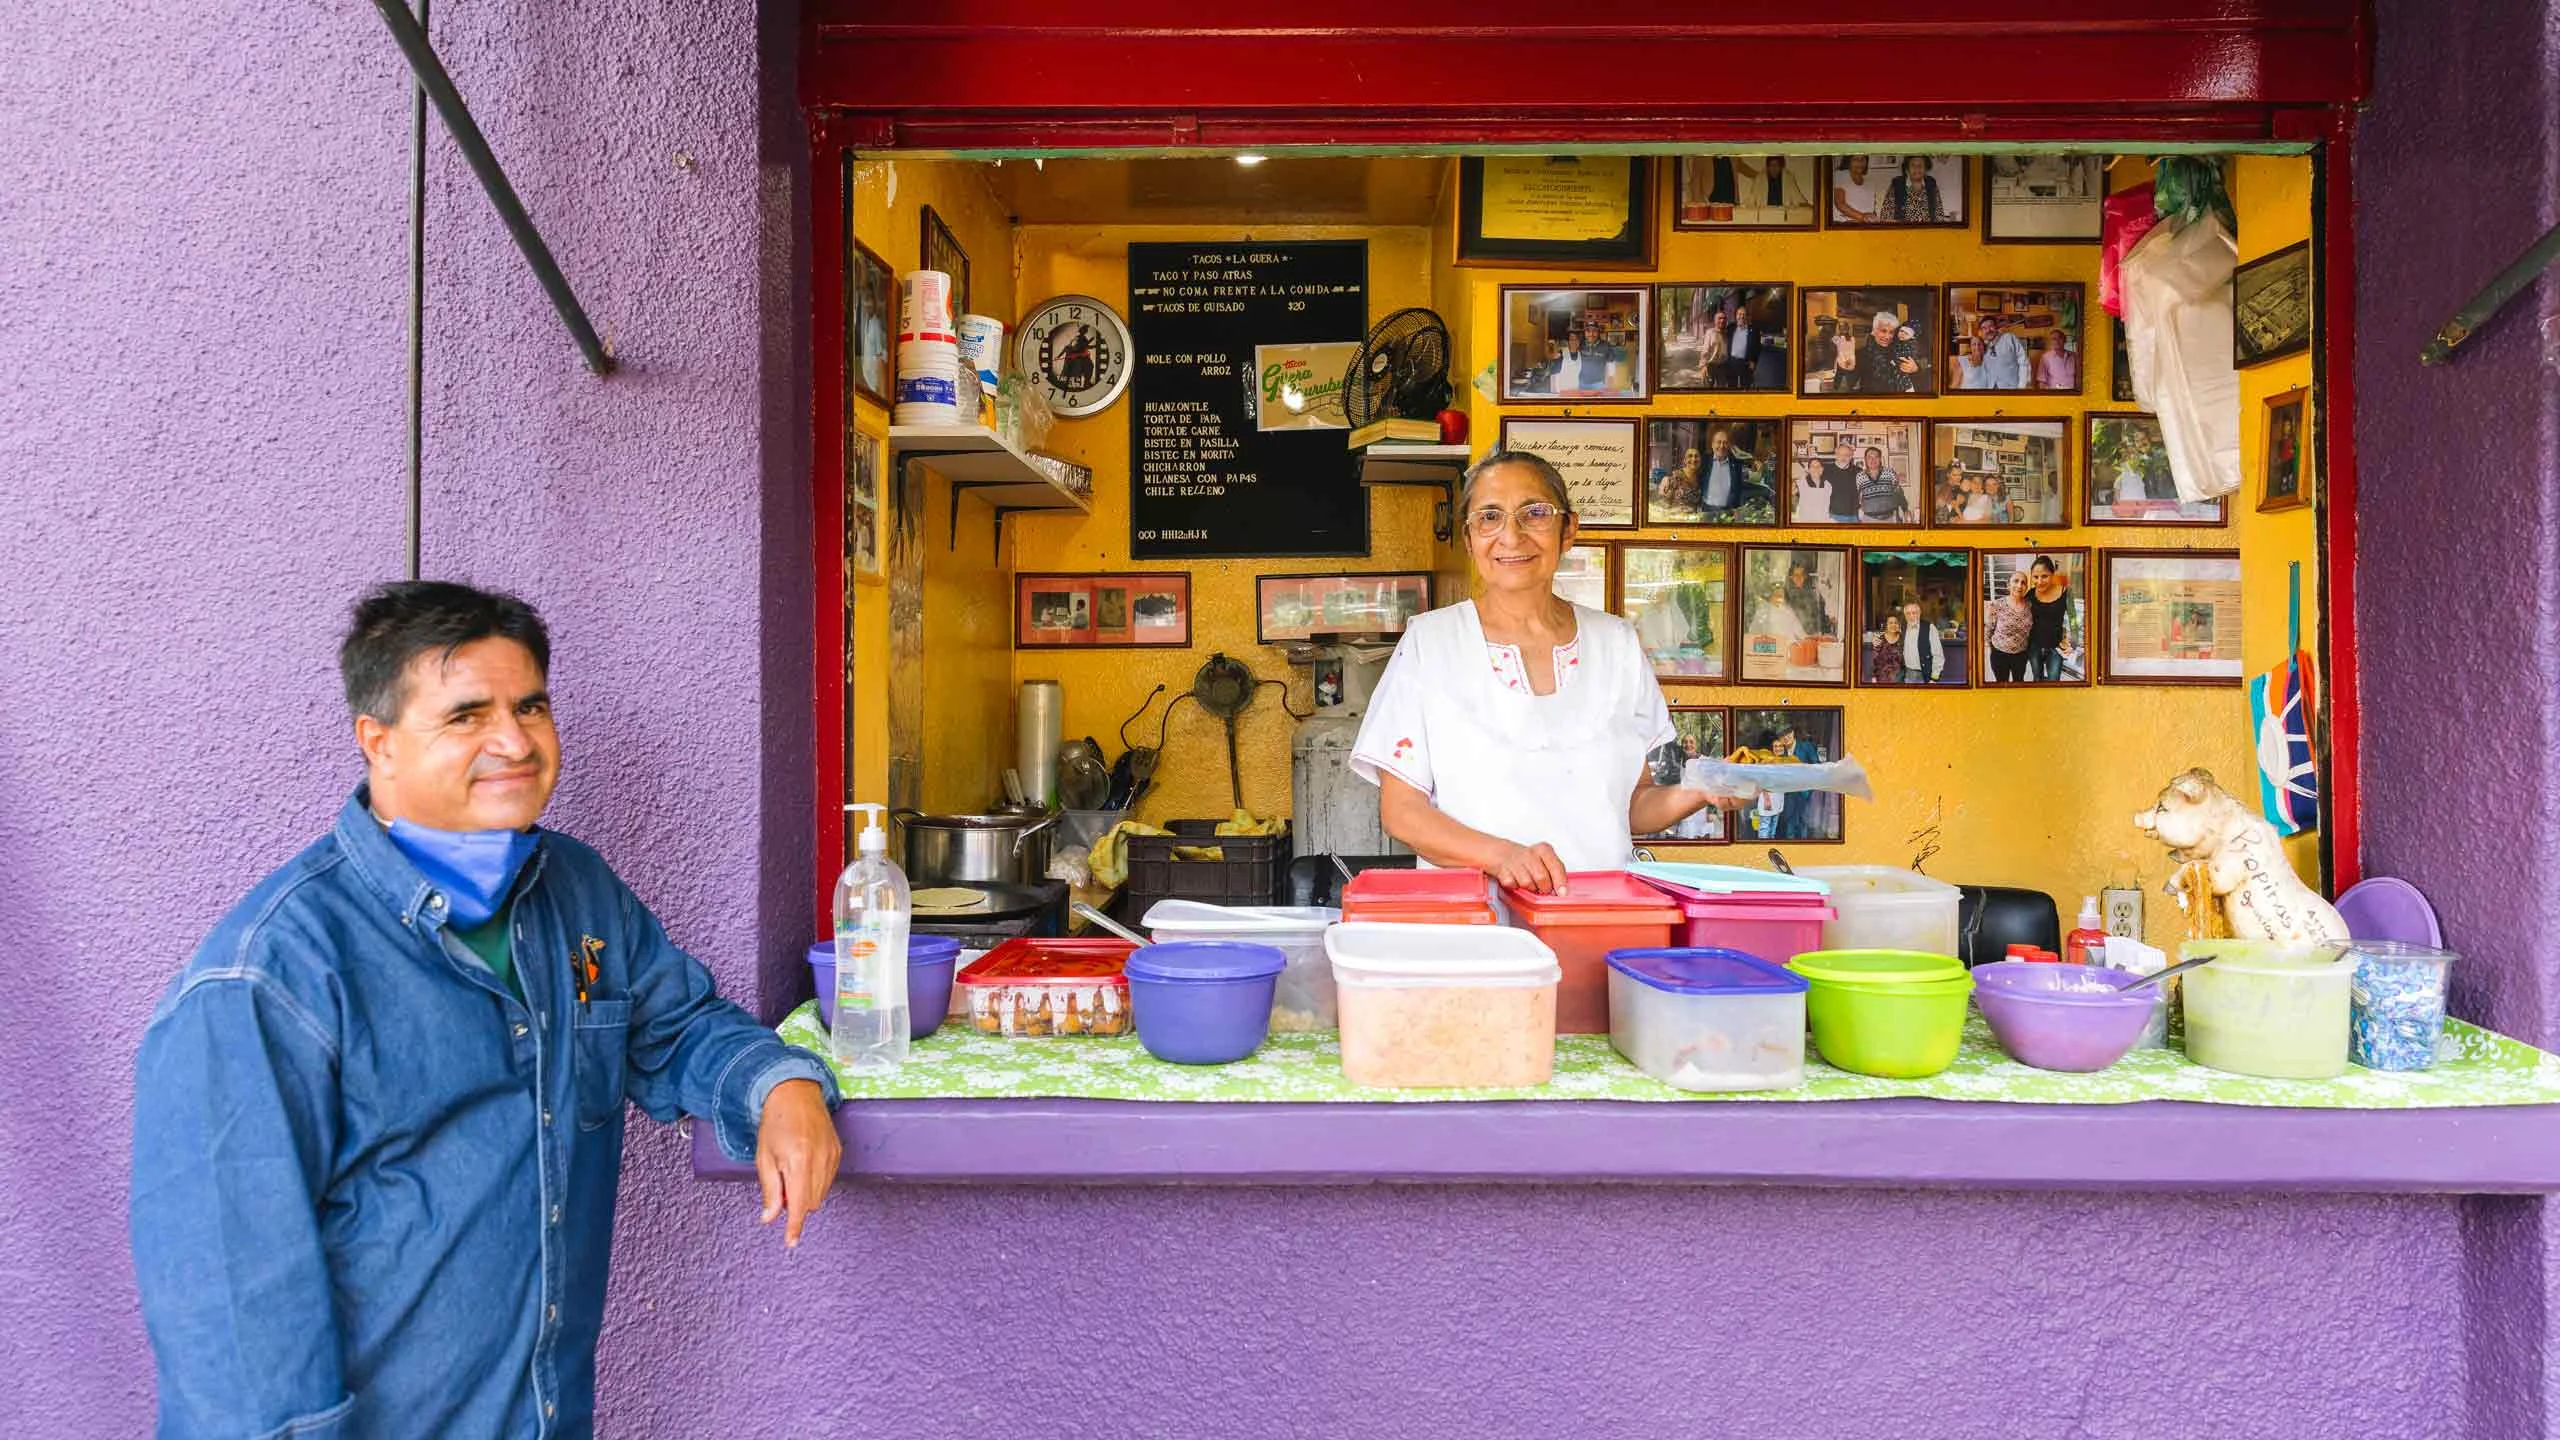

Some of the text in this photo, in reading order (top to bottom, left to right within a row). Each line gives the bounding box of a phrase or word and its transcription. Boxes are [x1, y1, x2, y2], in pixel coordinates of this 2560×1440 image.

[1193, 255, 1221, 264] TACOS
[1234, 255, 1246, 263] LA
[1153, 271, 1252, 280] TACO Y PASO ATRAS
[1163, 288, 1175, 296] NO
[1179, 287, 1208, 296] COMA
[1214, 287, 1255, 295] FRENTE
[1271, 286, 1284, 294] LA
[1290, 285, 1329, 294] COMIDA
[1157, 301, 1305, 312] TACOS DE GUISADO $20
[1069, 307, 1081, 319] 12
[1049, 313, 1058, 324] 11
[1095, 313, 1098, 324] 1
[1033, 328, 1044, 340] 10
[1114, 352, 1122, 365] 3
[1147, 354, 1226, 363] MOLE CON POLLO
[1201, 366, 1231, 375] ARROZ
[1032, 372, 1039, 384] 8
[1107, 374, 1115, 386] 4
[1048, 388, 1055, 400] 7
[1069, 395, 1077, 407] 6
[1146, 402, 1208, 411] HUANZONTLE
[1144, 415, 1221, 424] TORTA DE PAPA
[1145, 426, 1220, 436] TORTA DE CARNE
[1145, 438, 1239, 448] BISTEC EN PASILLA
[1145, 450, 1234, 459] BISTEC EN MORITA
[1144, 462, 1205, 472] CHICHARRON
[1145, 475, 1190, 483] MILANESA
[1197, 474, 1216, 483] CON
[1146, 486, 1224, 496] CHILE RELLENO
